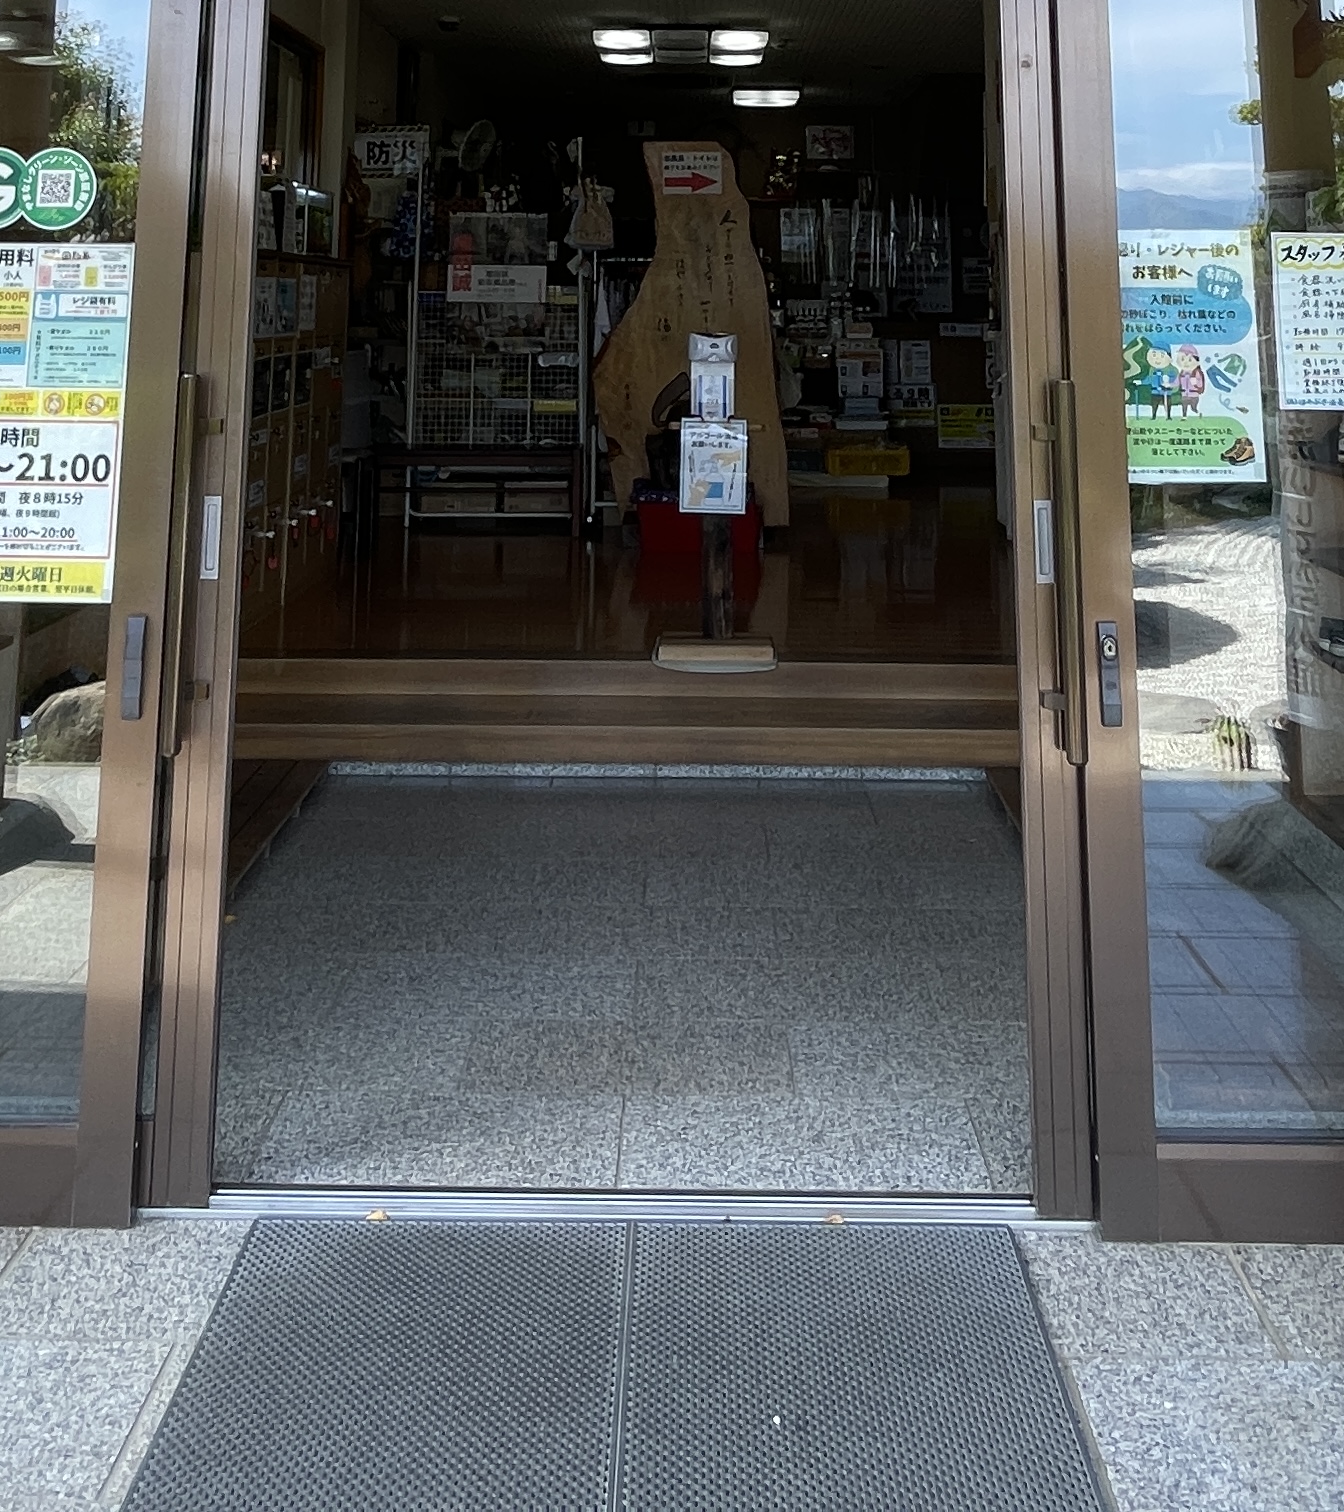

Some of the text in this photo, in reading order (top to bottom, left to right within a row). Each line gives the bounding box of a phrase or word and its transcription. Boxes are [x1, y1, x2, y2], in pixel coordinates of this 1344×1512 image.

[366, 140, 417, 165] 防災
[3, 271, 22, 280] 小人
[1132, 265, 1193, 280] お客様へ
[73, 297, 116, 306] レジ袋有料
[1122, 323, 1227, 334] れをはらってください。
[18, 491, 83, 505] 夜8時15分
